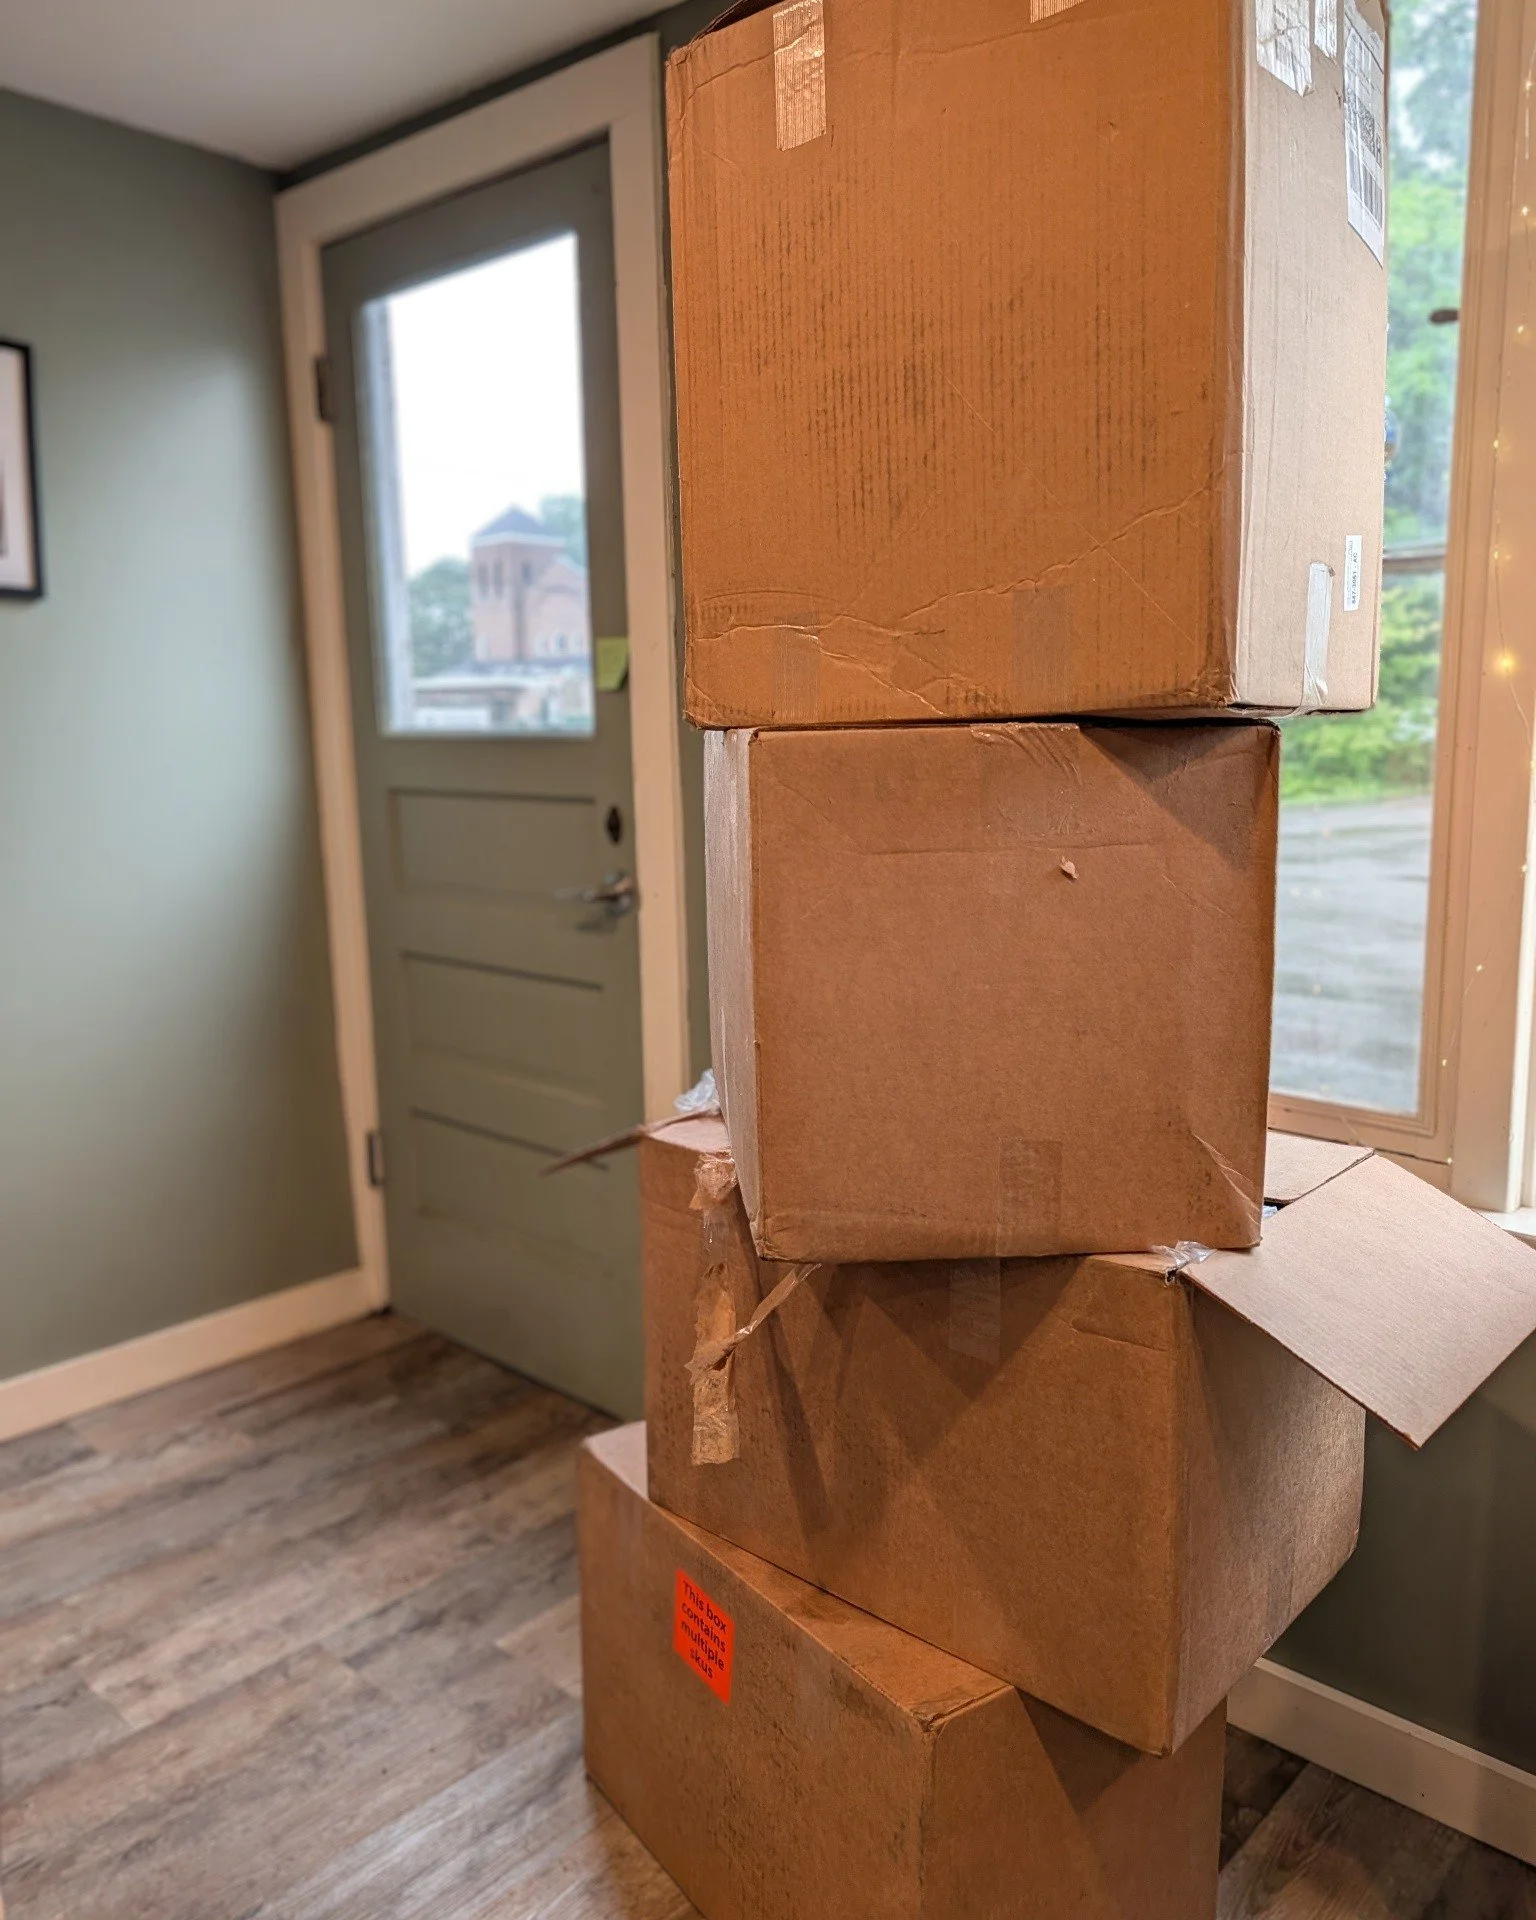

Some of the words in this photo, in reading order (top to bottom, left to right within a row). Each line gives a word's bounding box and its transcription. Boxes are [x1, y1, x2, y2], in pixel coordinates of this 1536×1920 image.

[681, 1602, 726, 1653] contains
[683, 1581, 704, 1611] This
[706, 1603, 727, 1634] box
[680, 1620, 725, 1671] multiple
[690, 1648, 713, 1679] skus
